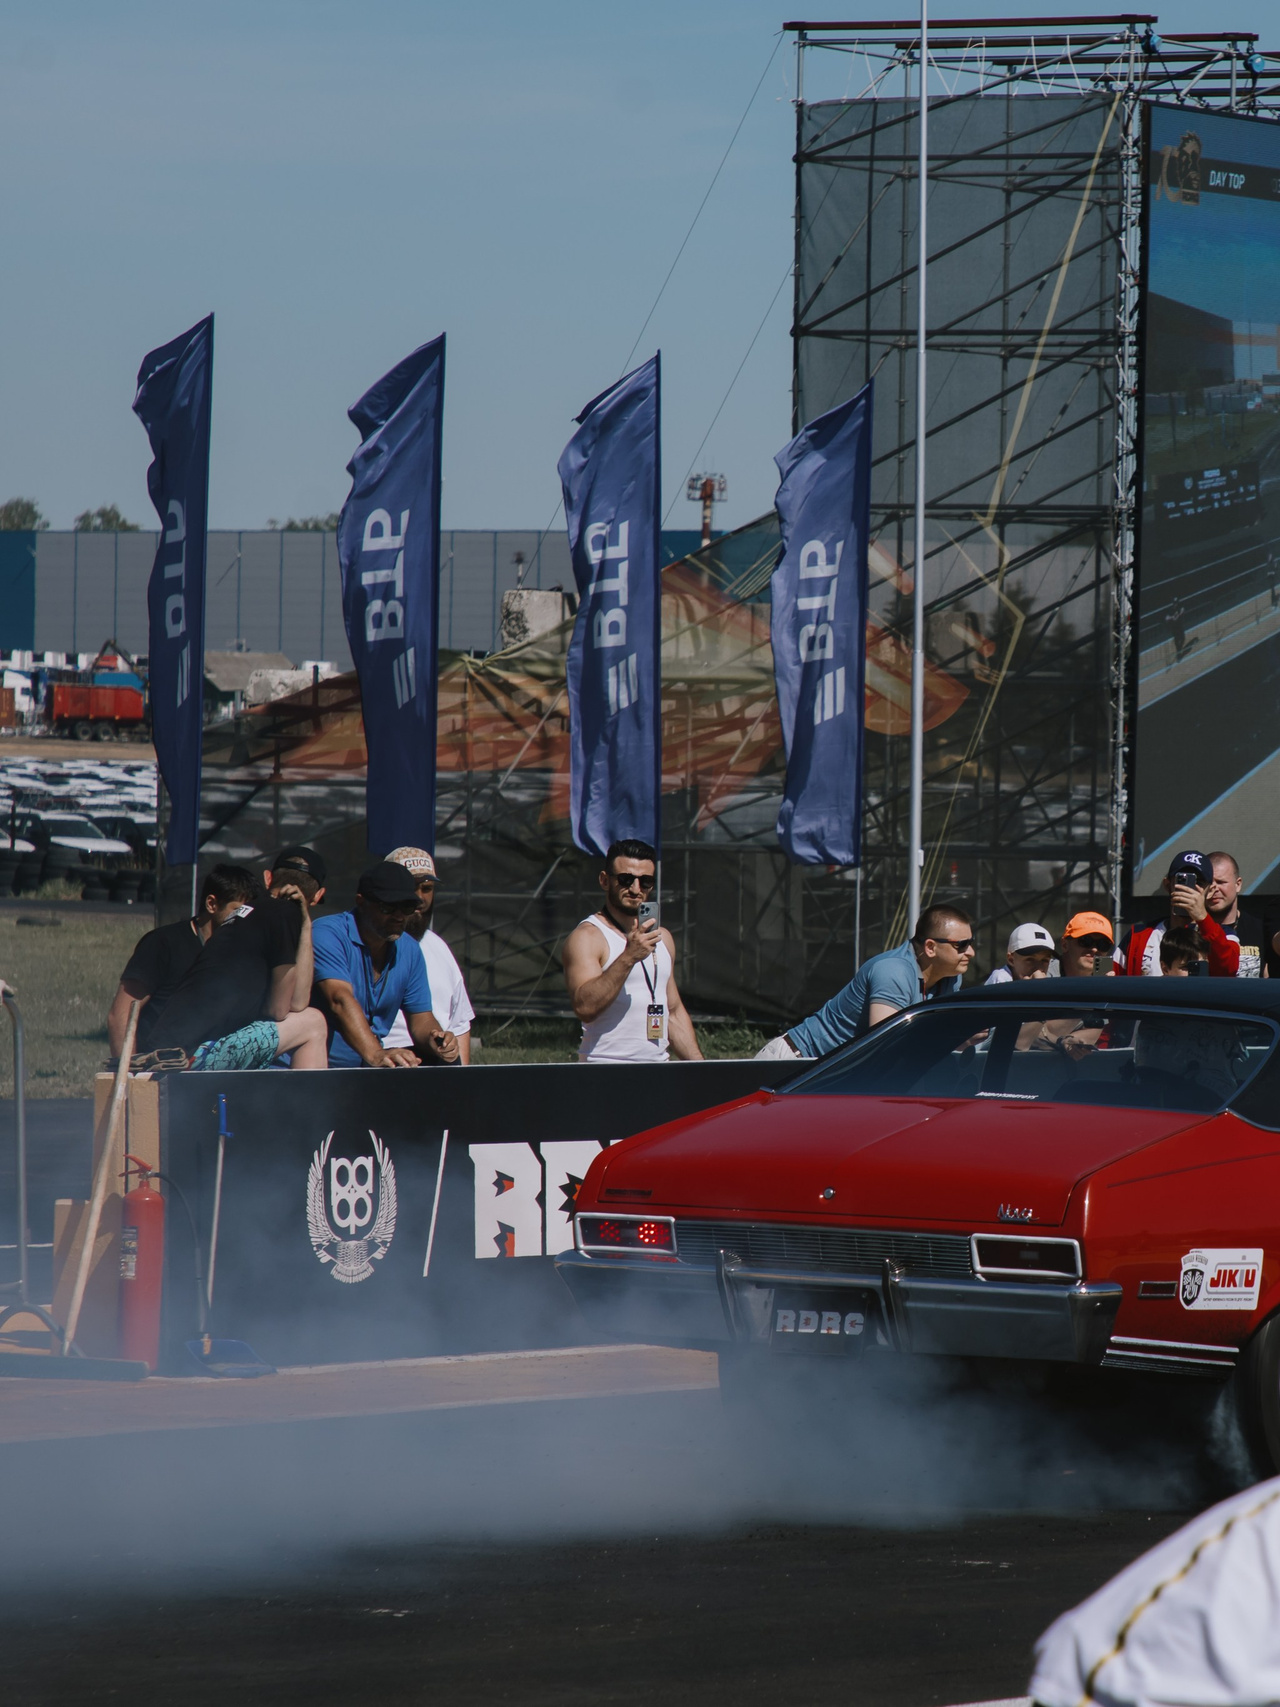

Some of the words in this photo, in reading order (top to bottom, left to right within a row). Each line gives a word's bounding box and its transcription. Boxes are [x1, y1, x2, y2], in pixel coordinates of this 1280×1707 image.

[1209, 170, 1227, 187] DAY
[1228, 173, 1246, 190] TOP
[404, 858, 431, 869] GUCCI
[776, 1309, 864, 1335] RDRC
